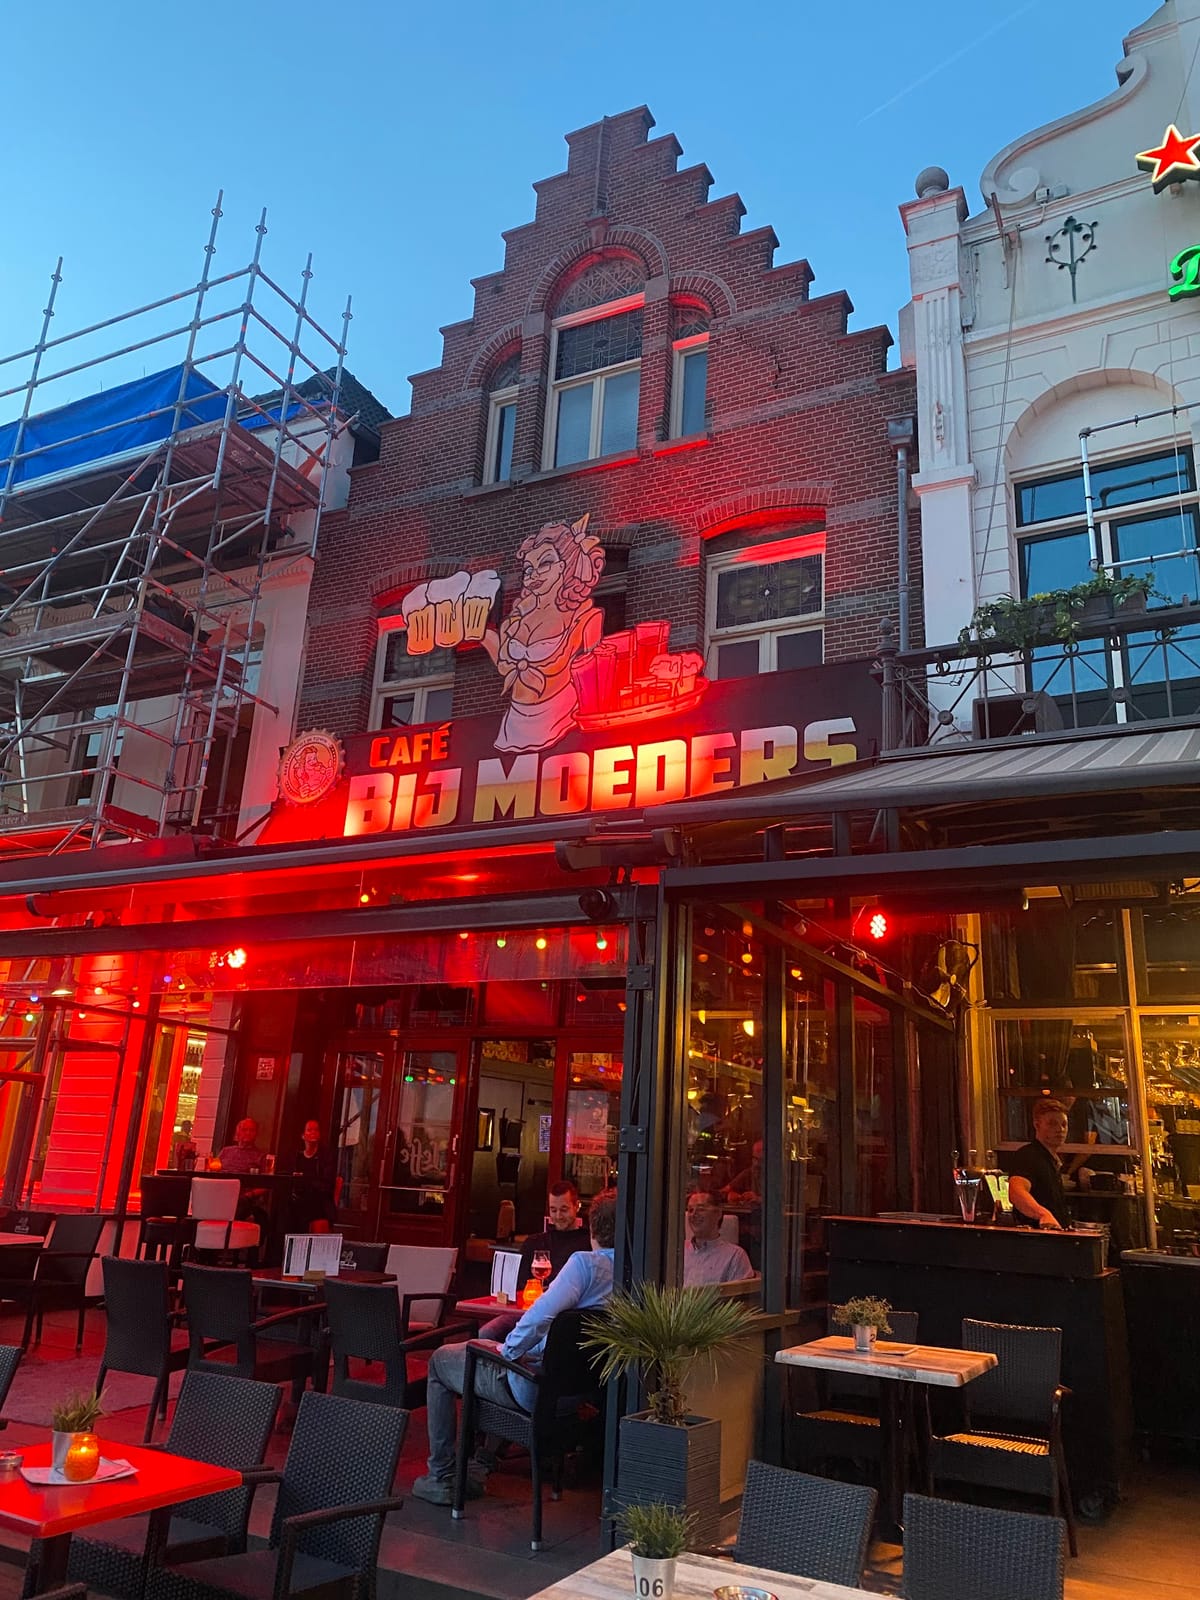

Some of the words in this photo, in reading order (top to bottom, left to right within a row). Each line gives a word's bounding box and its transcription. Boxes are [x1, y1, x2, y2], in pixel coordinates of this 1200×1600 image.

[344, 768, 462, 837] BIJ
[472, 717, 857, 823] MOEDERS
[369, 722, 452, 768] CAFÉ
